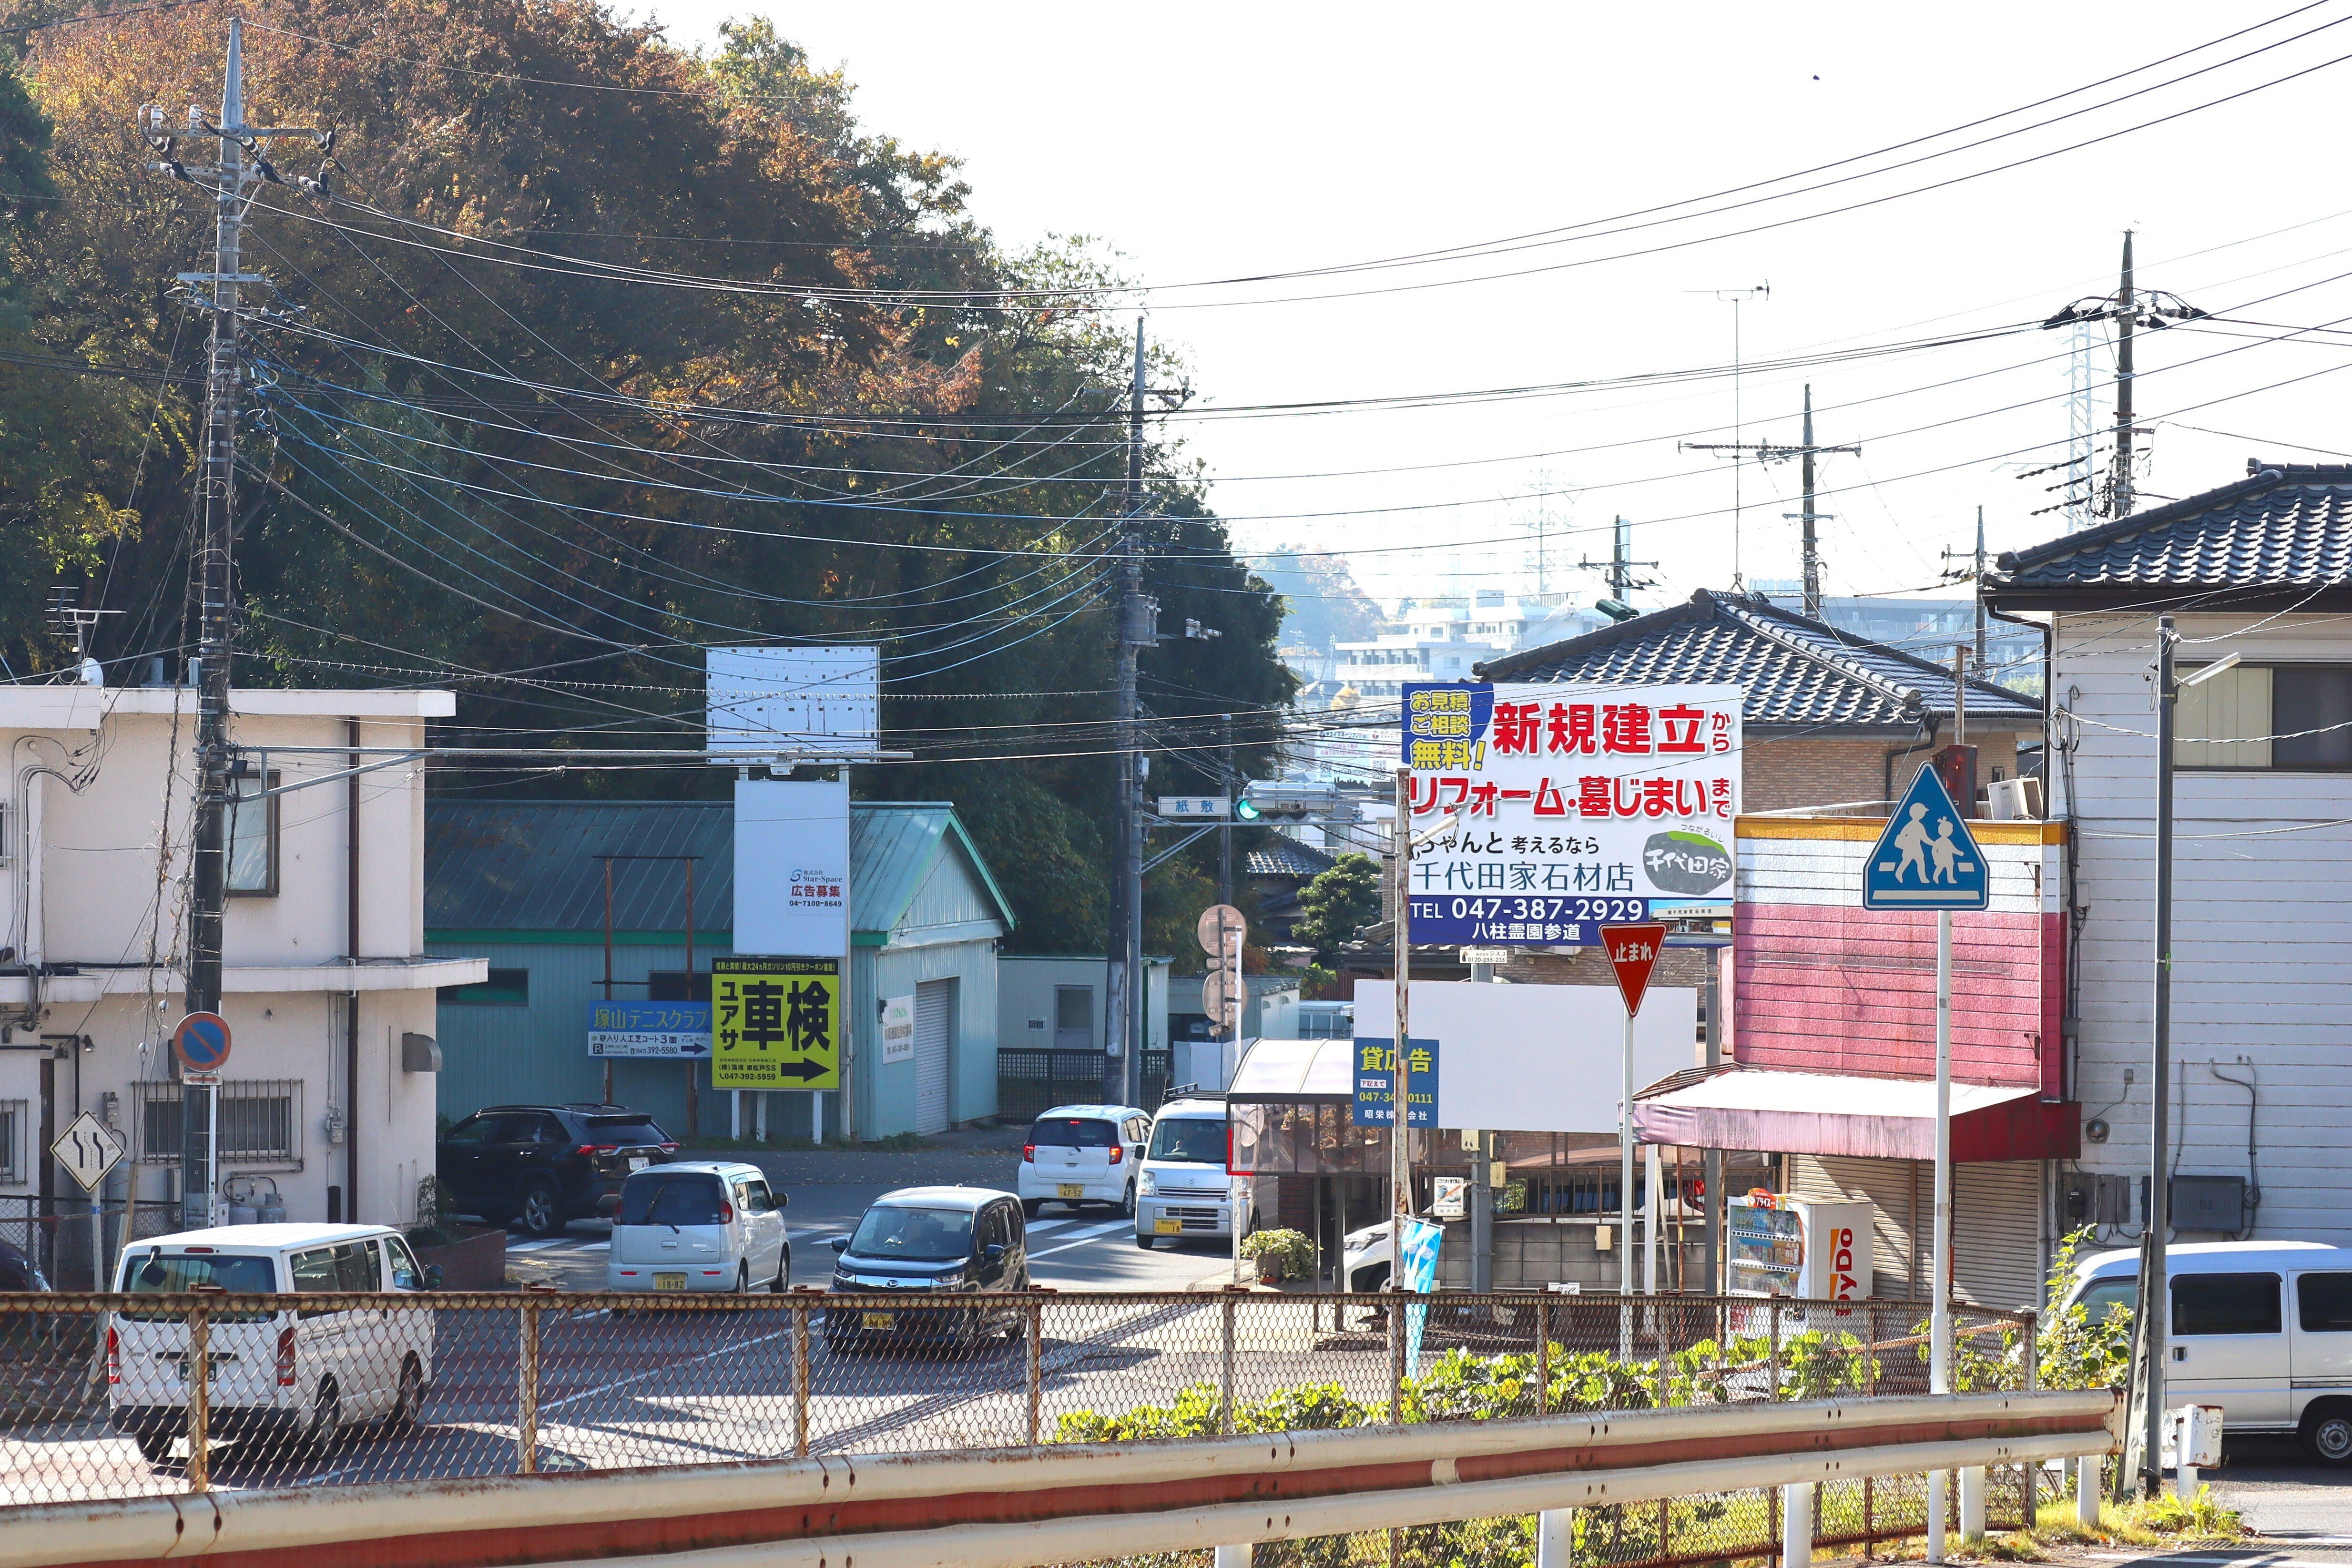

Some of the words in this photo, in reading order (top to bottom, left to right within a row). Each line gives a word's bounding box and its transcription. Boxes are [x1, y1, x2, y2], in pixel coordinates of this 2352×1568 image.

[1412, 692, 1469, 712] お見積
[1413, 715, 1469, 734] ご相談
[1492, 703, 1706, 754] 新規建立
[1712, 712, 1731, 752] から
[1412, 740, 1486, 771] 無料!
[1175, 800, 1214, 813] 紙敷
[1409, 777, 1705, 817] リフォーム・墓じまい
[1712, 778, 1731, 818] まで
[1681, 824, 1724, 843] つながるいし
[1511, 835, 1599, 855] 考えるなら
[1645, 848, 1729, 879] 千代田家
[1413, 861, 1633, 892] 千代田家石材店
[791, 885, 840, 897] 広告募集
[1410, 903, 1443, 919] TEL
[1452, 898, 1643, 921] 047-387-2929
[1472, 923, 1581, 941] 八柱霊園参道
[1614, 941, 1653, 962] 止まれ
[594, 1008, 708, 1029] 塚山テニスクラブ
[720, 981, 738, 1051] ユアサ
[742, 980, 831, 1052] 車検
[1364, 1109, 1427, 1120] 昭栄株会社
